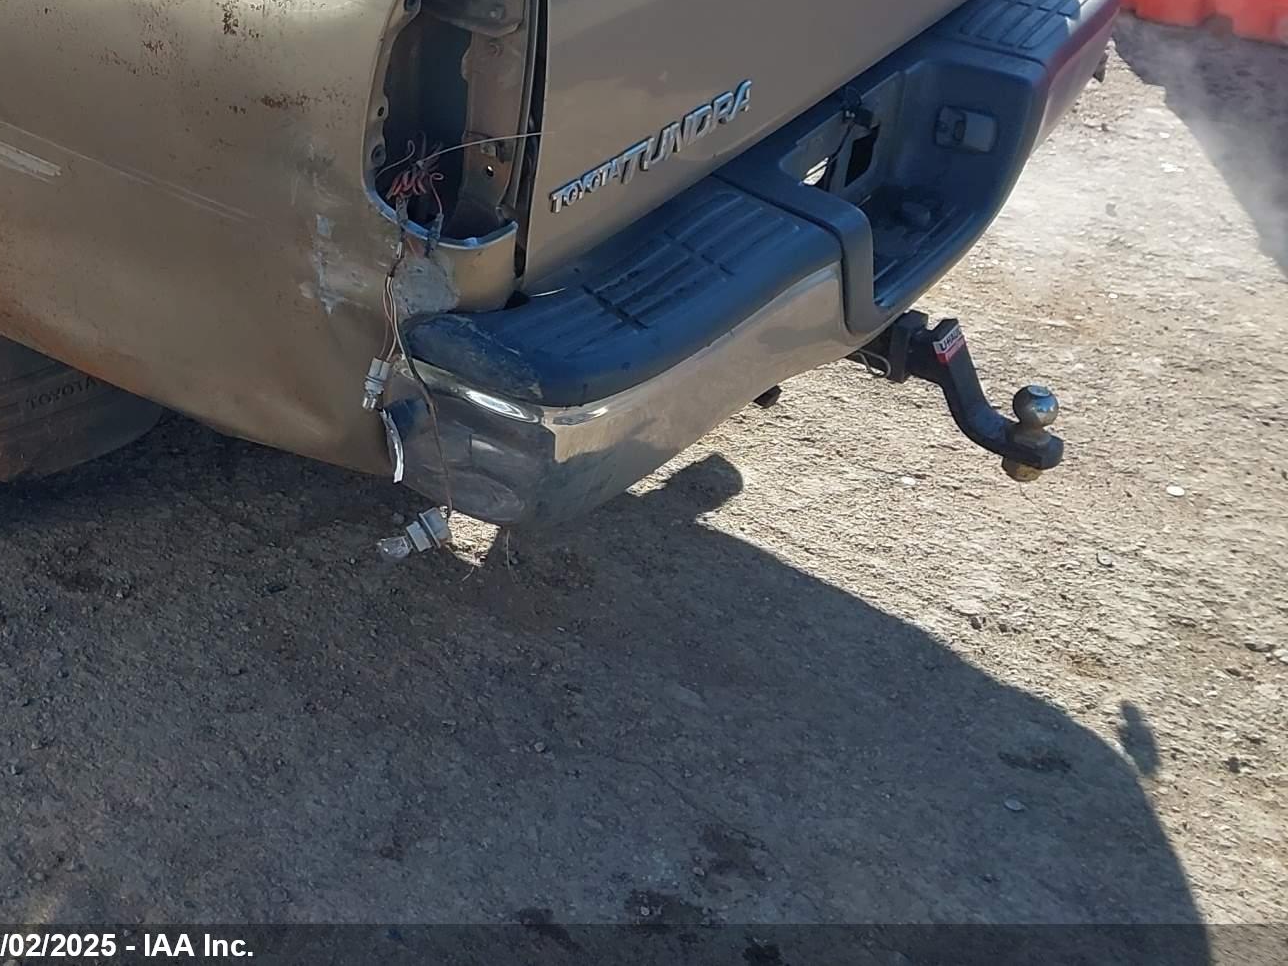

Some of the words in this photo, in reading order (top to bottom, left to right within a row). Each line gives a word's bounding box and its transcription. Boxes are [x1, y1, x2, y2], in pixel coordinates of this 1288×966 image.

[549, 161, 619, 213] TOYOTA
[614, 79, 752, 184] TUNDRA
[25, 375, 98, 410] TOYOTA
